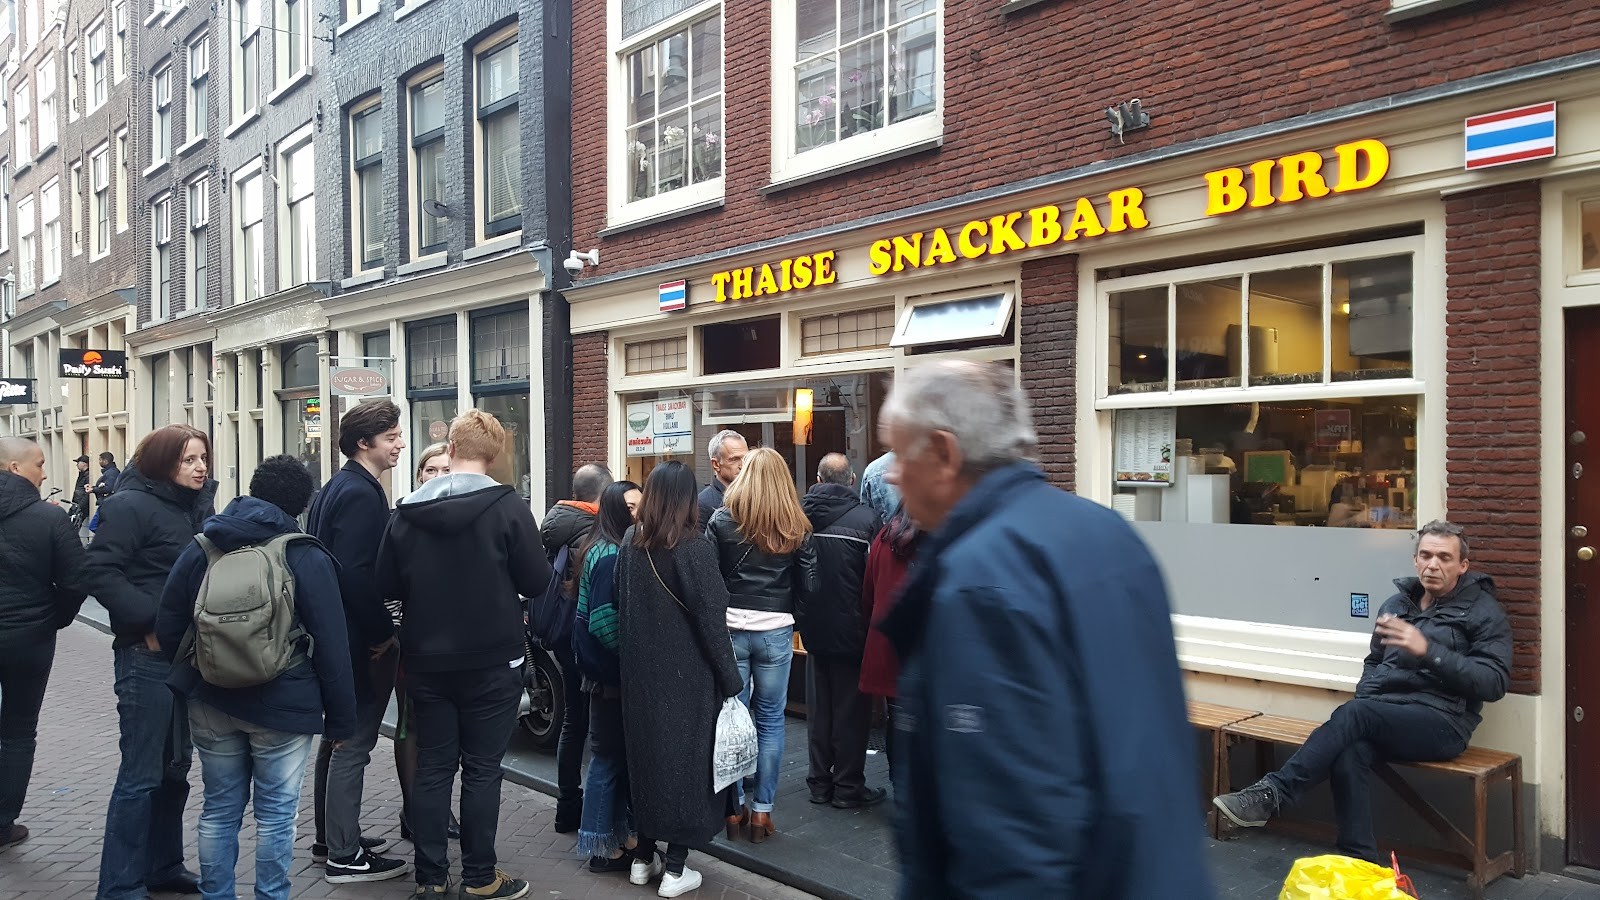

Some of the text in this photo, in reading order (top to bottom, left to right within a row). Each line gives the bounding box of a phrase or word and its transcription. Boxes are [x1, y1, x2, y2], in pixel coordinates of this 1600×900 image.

[711, 138, 1390, 302] THAISE SNACKBAR BIRD
[63, 363, 92, 376] Daily
[93, 364, 122, 375] Sushi
